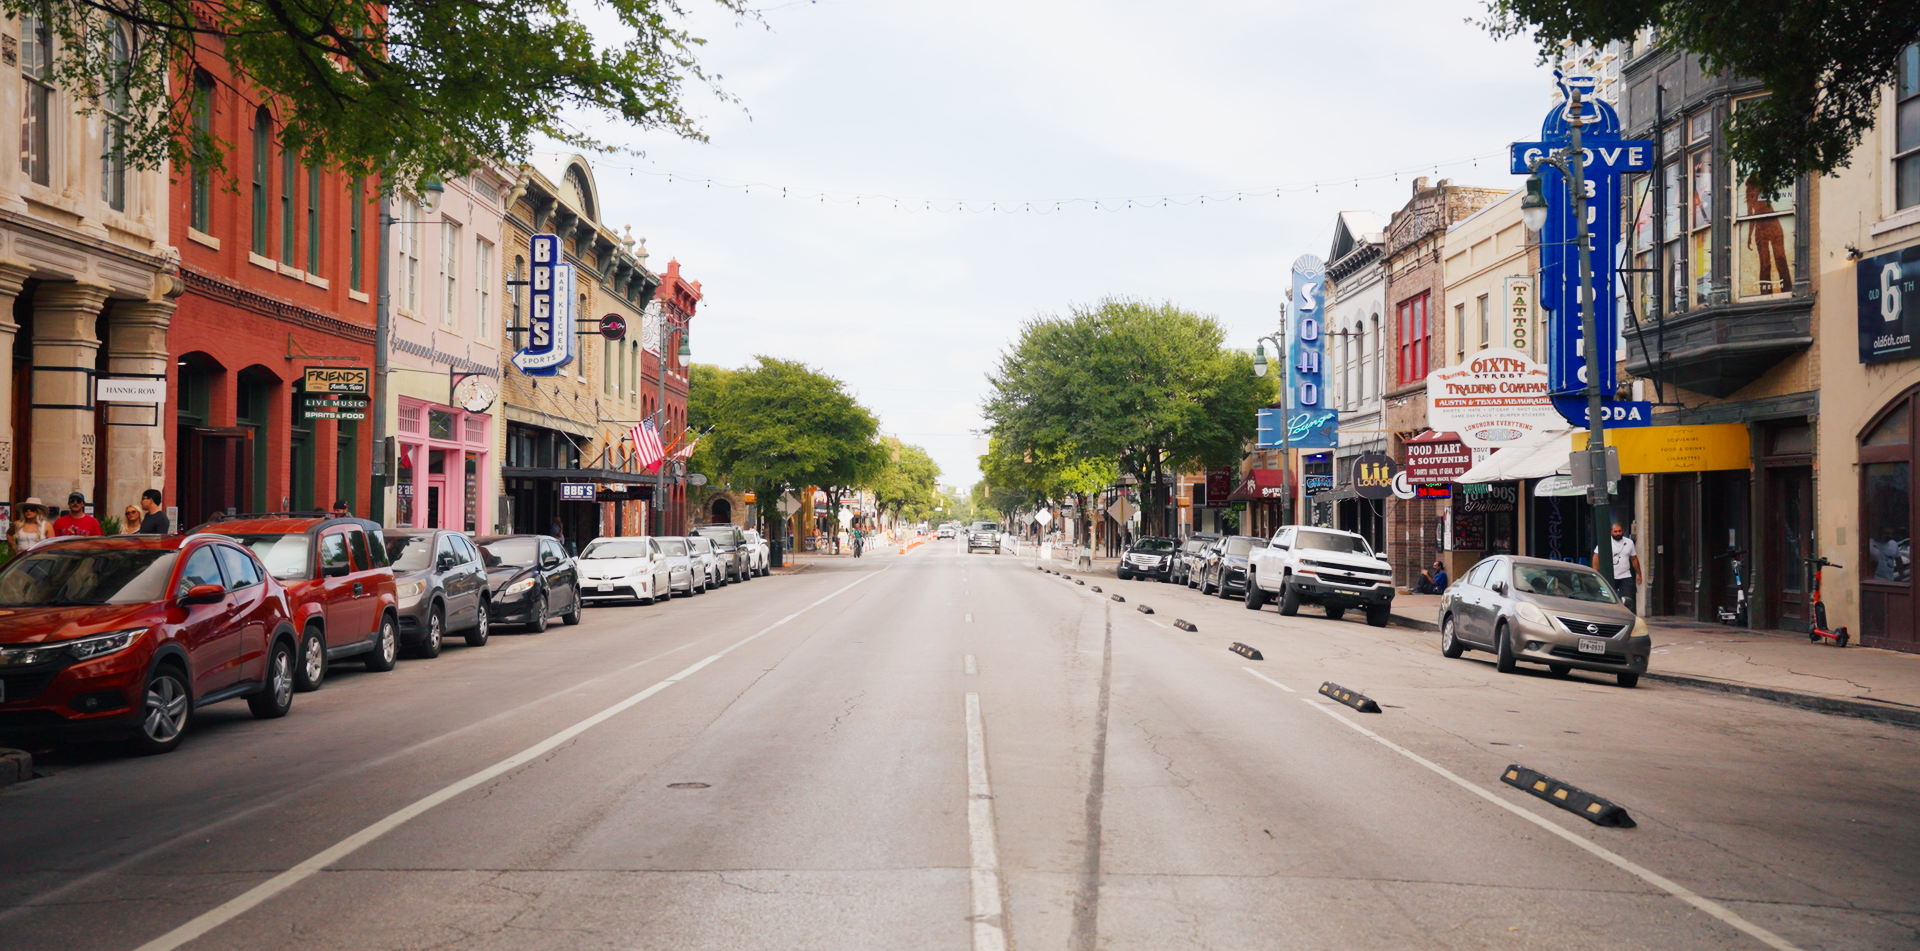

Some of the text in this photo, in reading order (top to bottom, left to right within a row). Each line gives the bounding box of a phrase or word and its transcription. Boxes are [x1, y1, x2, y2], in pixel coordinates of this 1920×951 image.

[531, 239, 551, 346] BBG'S
[1868, 288, 1880, 300] OLD
[1513, 286, 1527, 348] TATTOO
[1296, 282, 1319, 405] SOHO
[1873, 334, 1910, 349] old6th.com
[522, 354, 557, 364] SPORTS
[307, 370, 364, 383] FRIENDS
[1446, 383, 1496, 396] TRADING
[1464, 420, 1533, 432] LONGHORN EVERYTHING
[1408, 445, 1432, 456] FOOD
[1435, 443, 1461, 454] MART
[1418, 455, 1469, 465] SOUVENIRS
[1360, 462, 1390, 480] Lit
[564, 485, 593, 496] BBG'S
